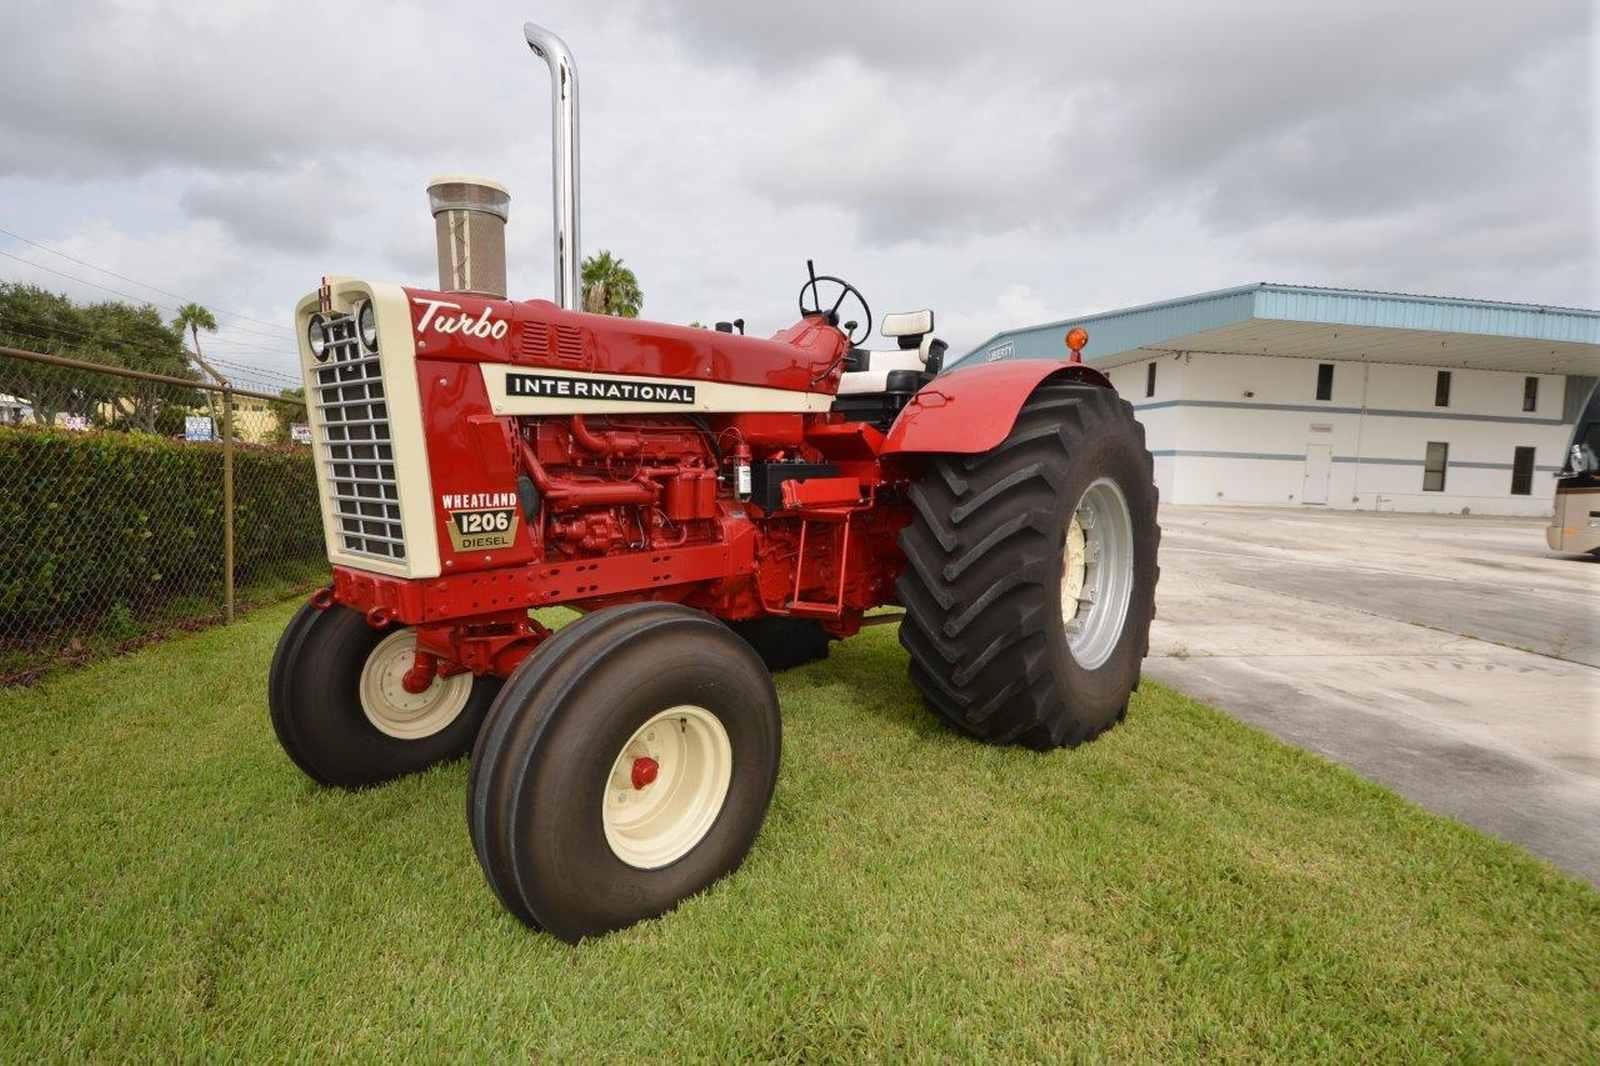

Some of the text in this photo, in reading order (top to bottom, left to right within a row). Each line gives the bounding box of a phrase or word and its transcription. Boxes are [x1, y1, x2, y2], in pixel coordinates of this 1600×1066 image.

[412, 297, 508, 340] Turbo
[515, 378, 693, 402] INTERNATIONAL
[442, 492, 517, 509] WHEATLAND
[461, 512, 509, 533] 1206
[462, 536, 509, 548] DIESEL
